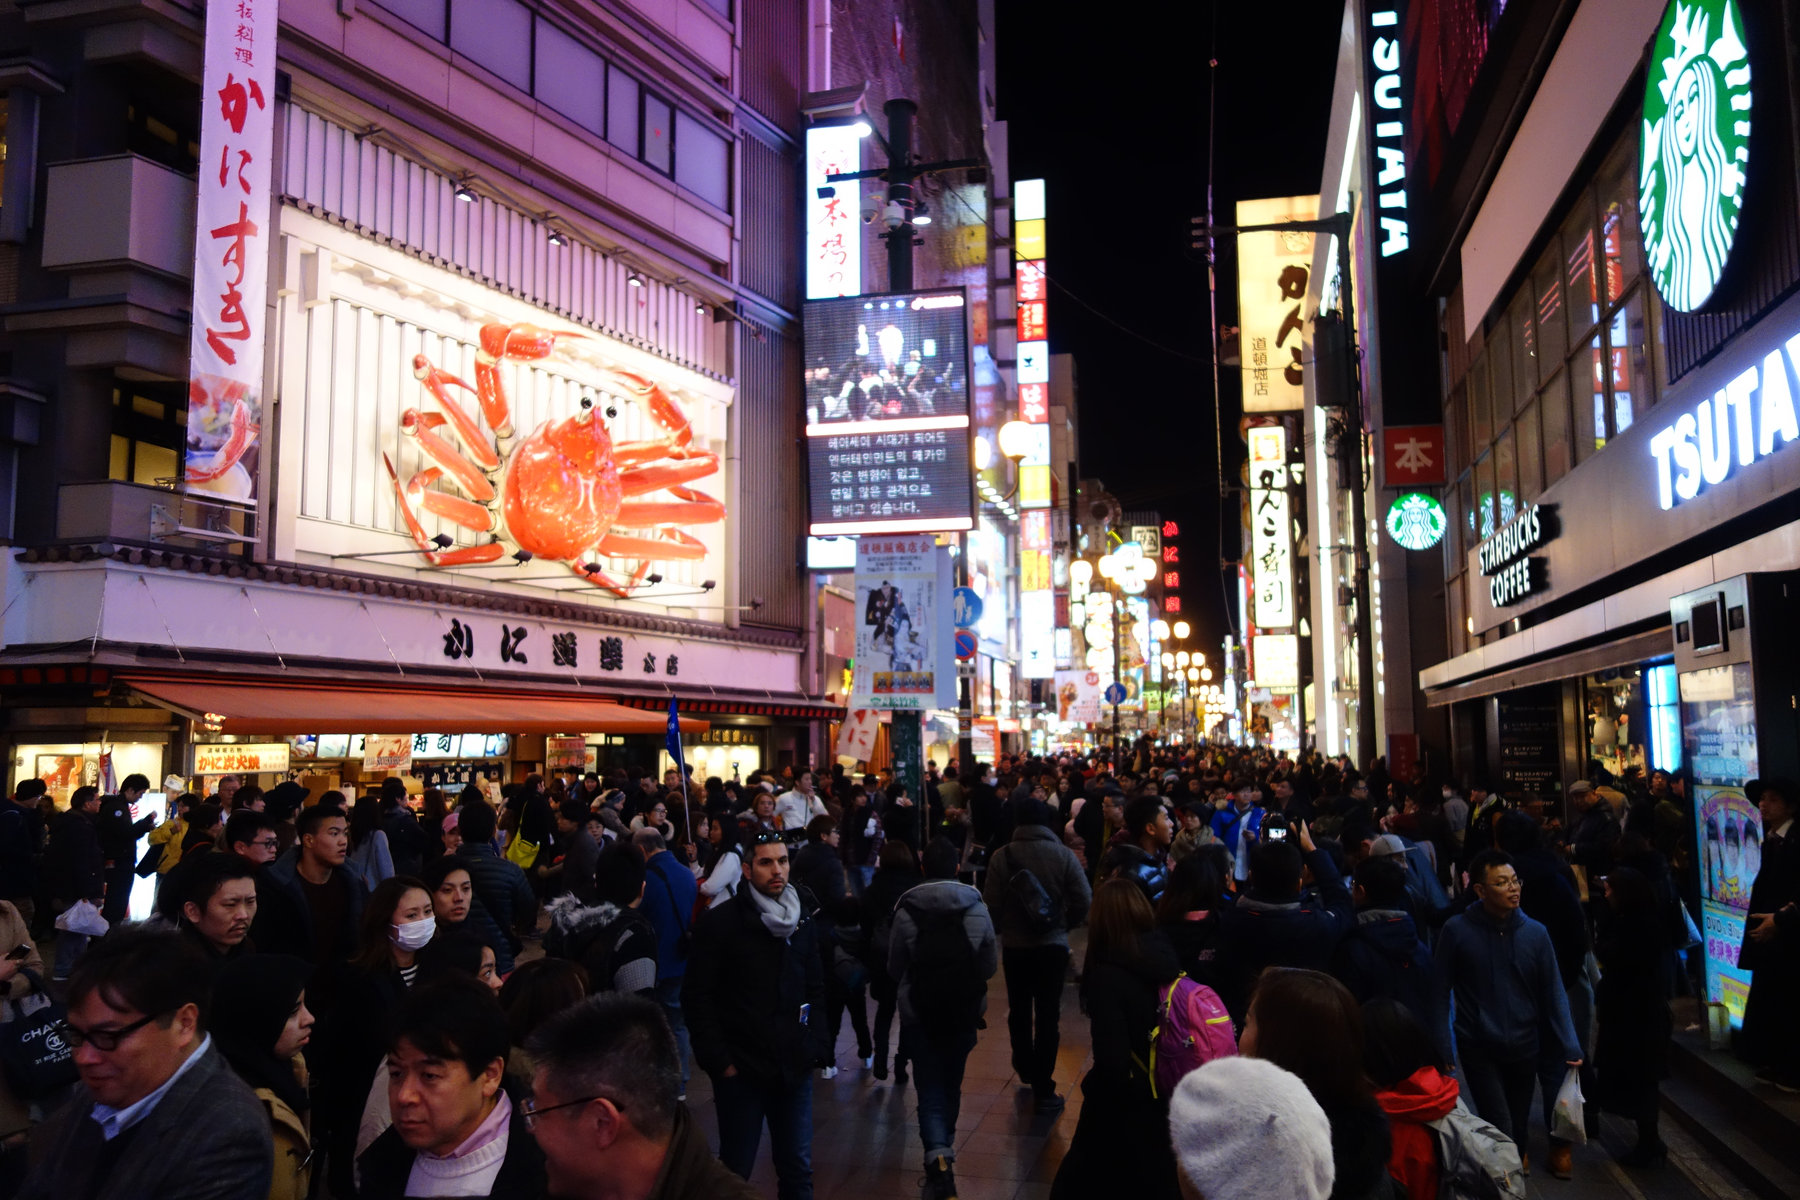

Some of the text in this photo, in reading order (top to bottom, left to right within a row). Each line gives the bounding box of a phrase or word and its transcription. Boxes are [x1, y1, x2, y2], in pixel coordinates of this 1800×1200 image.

[206, 72, 266, 366] かにすき
[817, 198, 848, 297] 本場の
[1252, 337, 1269, 397] 道頓堀店
[828, 448, 946, 467] 엔터테인먼트의 메카인
[876, 433, 909, 446] 시대가
[914, 431, 946, 444] 되어도
[1394, 437, 1433, 474] 本
[830, 470, 853, 483] 것은
[858, 468, 891, 482] 변함이
[830, 487, 853, 500] 연일
[886, 483, 932, 498] 관객으로
[870, 500, 920, 515] 있습니다.
[1479, 503, 1540, 577] STARBUCKS
[1490, 556, 1531, 609] COFFEE
[443, 617, 624, 671] かに道楽
